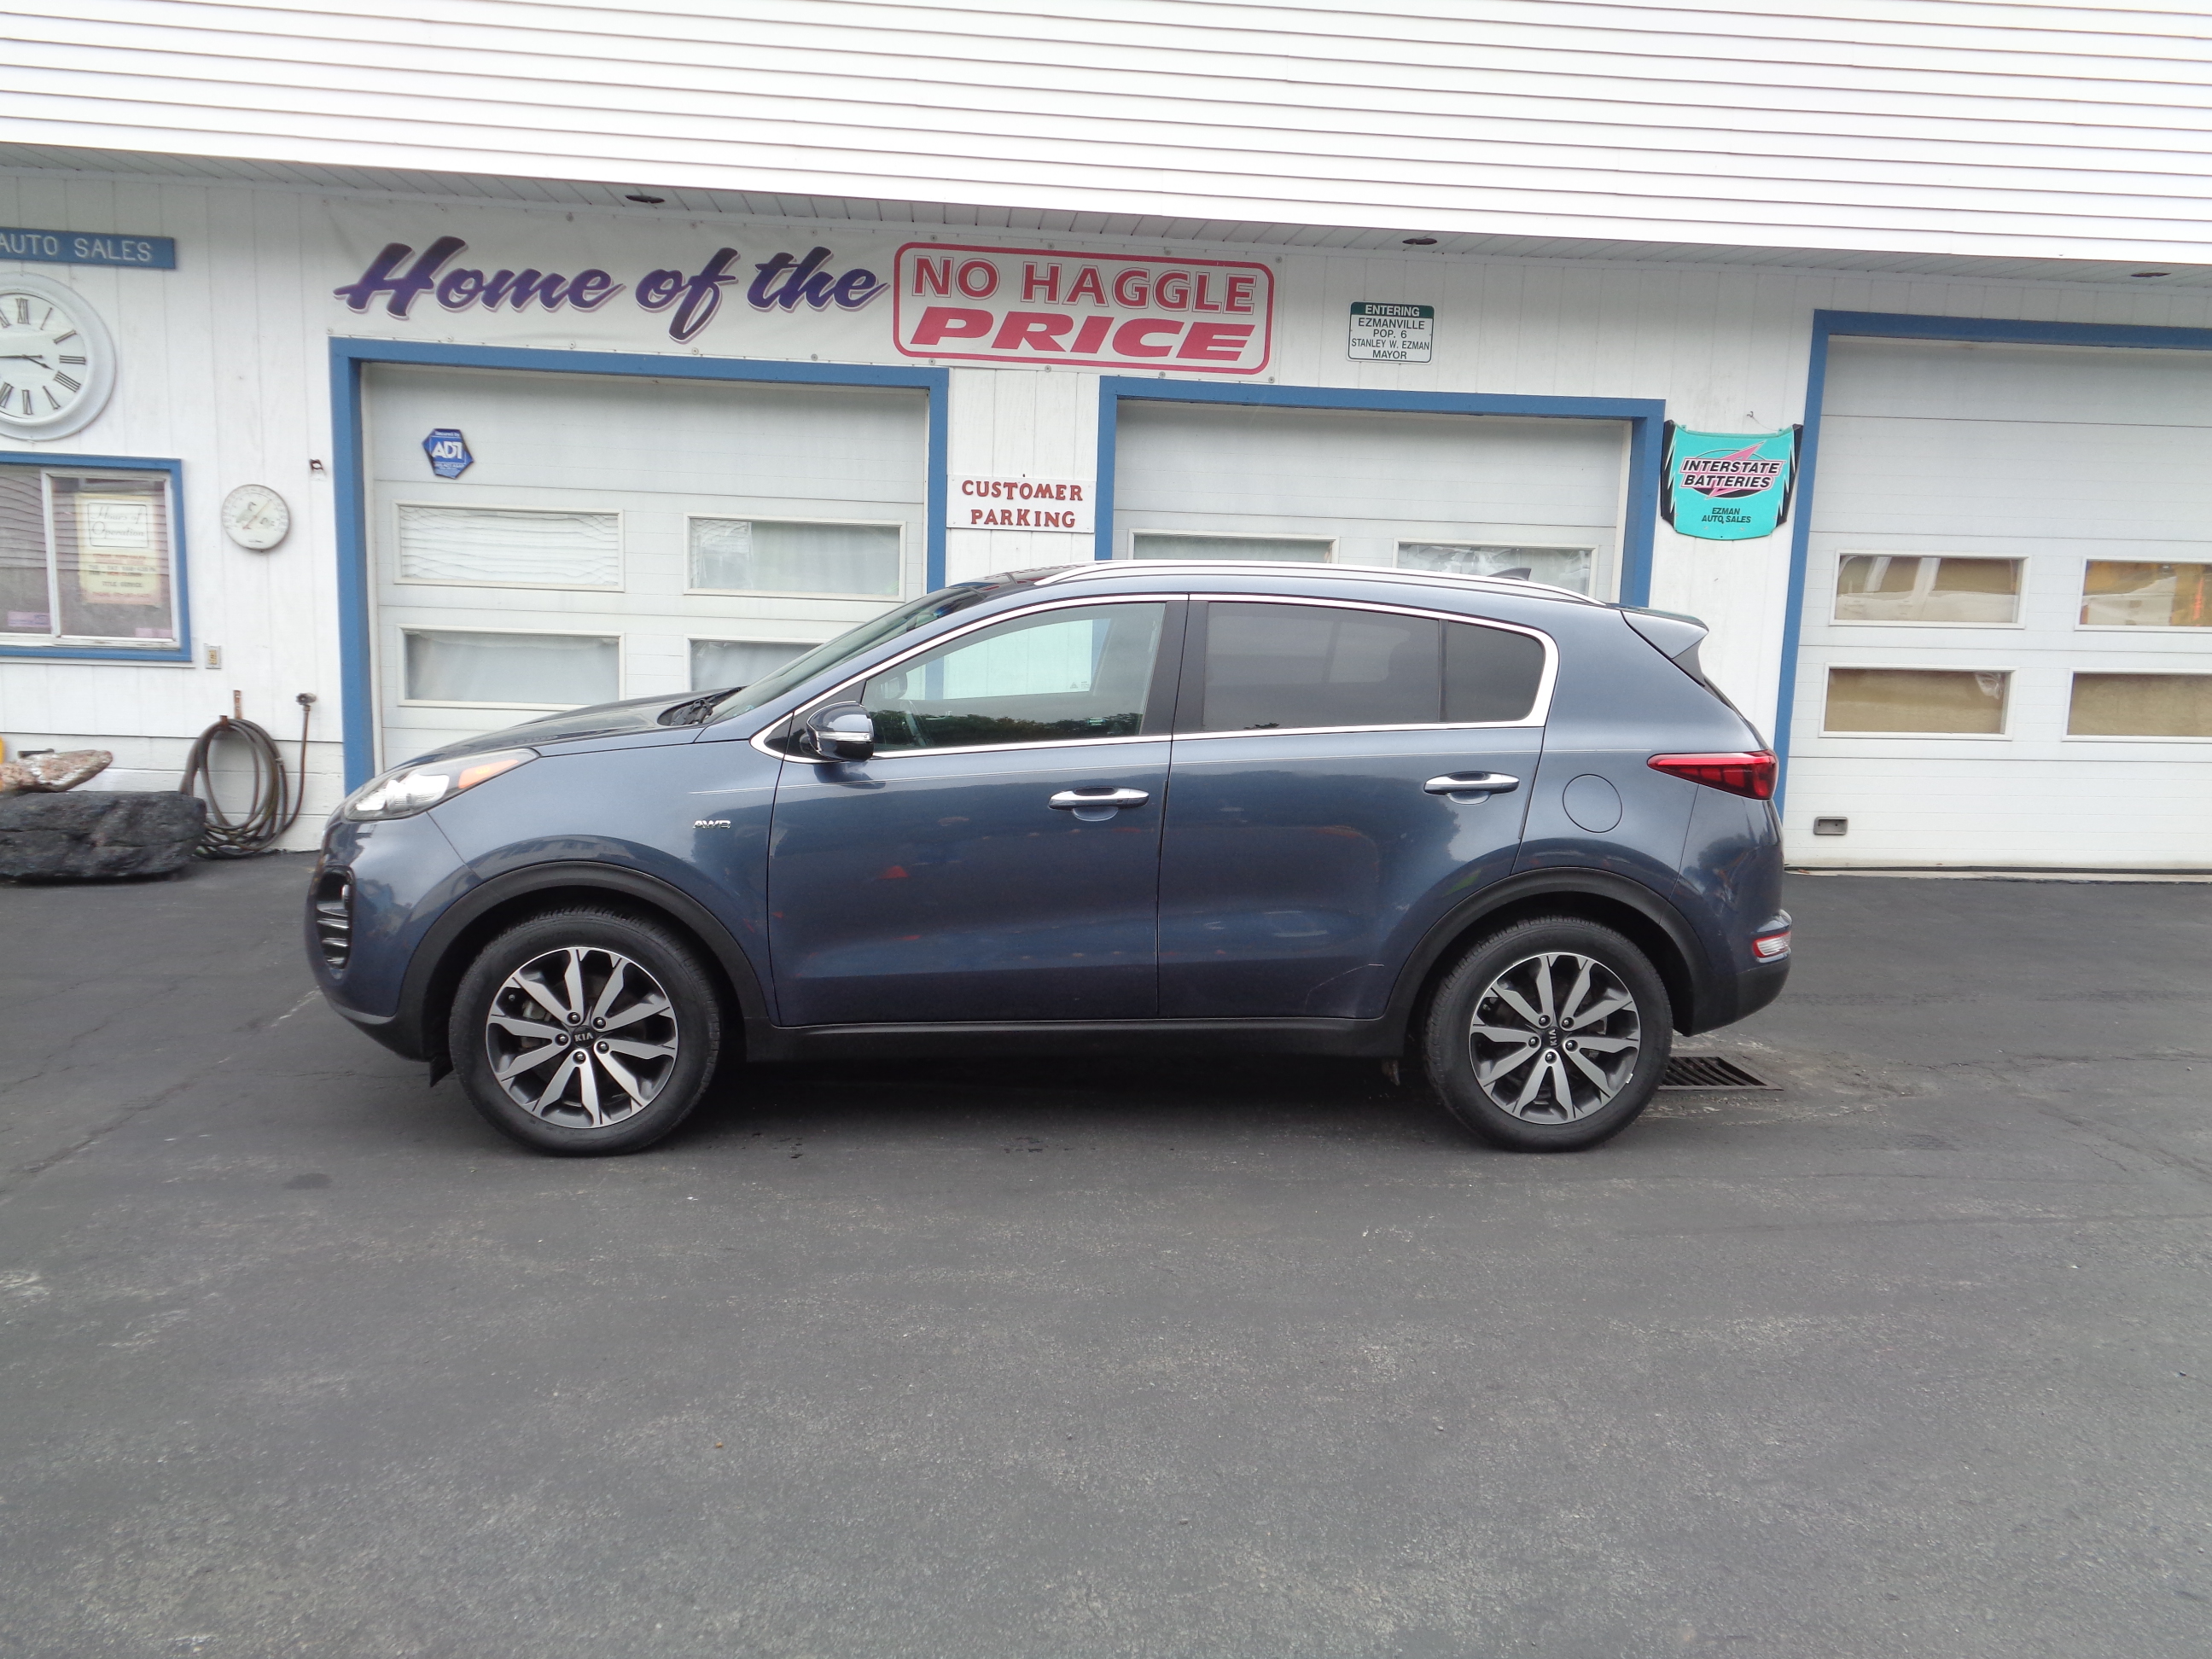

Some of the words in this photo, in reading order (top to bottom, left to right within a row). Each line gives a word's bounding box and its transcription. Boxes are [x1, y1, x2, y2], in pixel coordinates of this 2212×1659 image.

[0, 231, 59, 256] AUTO
[74, 237, 153, 262] SALES
[333, 235, 626, 321] Home
[635, 246, 741, 344] of
[748, 246, 891, 313] the
[911, 254, 1000, 300] NO
[1021, 261, 1258, 316] HAGGLE
[1365, 304, 1420, 317] ENTERING
[1358, 317, 1425, 330] EZMANVILLE
[910, 306, 1256, 362] PRICE
[1373, 329, 1396, 339] POP.
[1400, 329, 1407, 339] 6
[1351, 337, 1387, 348] STANLEY
[1389, 340, 1399, 349] W.
[1401, 341, 1429, 351] EZMAN
[1372, 349, 1407, 359] MAYOR
[432, 440, 463, 459] ADT
[1683, 459, 1780, 474] INTERSTATE
[1684, 474, 1772, 487] BATTERIES
[962, 480, 1083, 501] CUSTOMER
[90, 506, 127, 520] Hours
[131, 507, 143, 524] of
[970, 509, 1076, 528] PARKING
[1711, 507, 1740, 515] EZMAN
[91, 521, 144, 538] Operation
[692, 819, 731, 829] AWD
[574, 1032, 594, 1042] KIA
[1548, 1028, 1557, 1046] KIA
